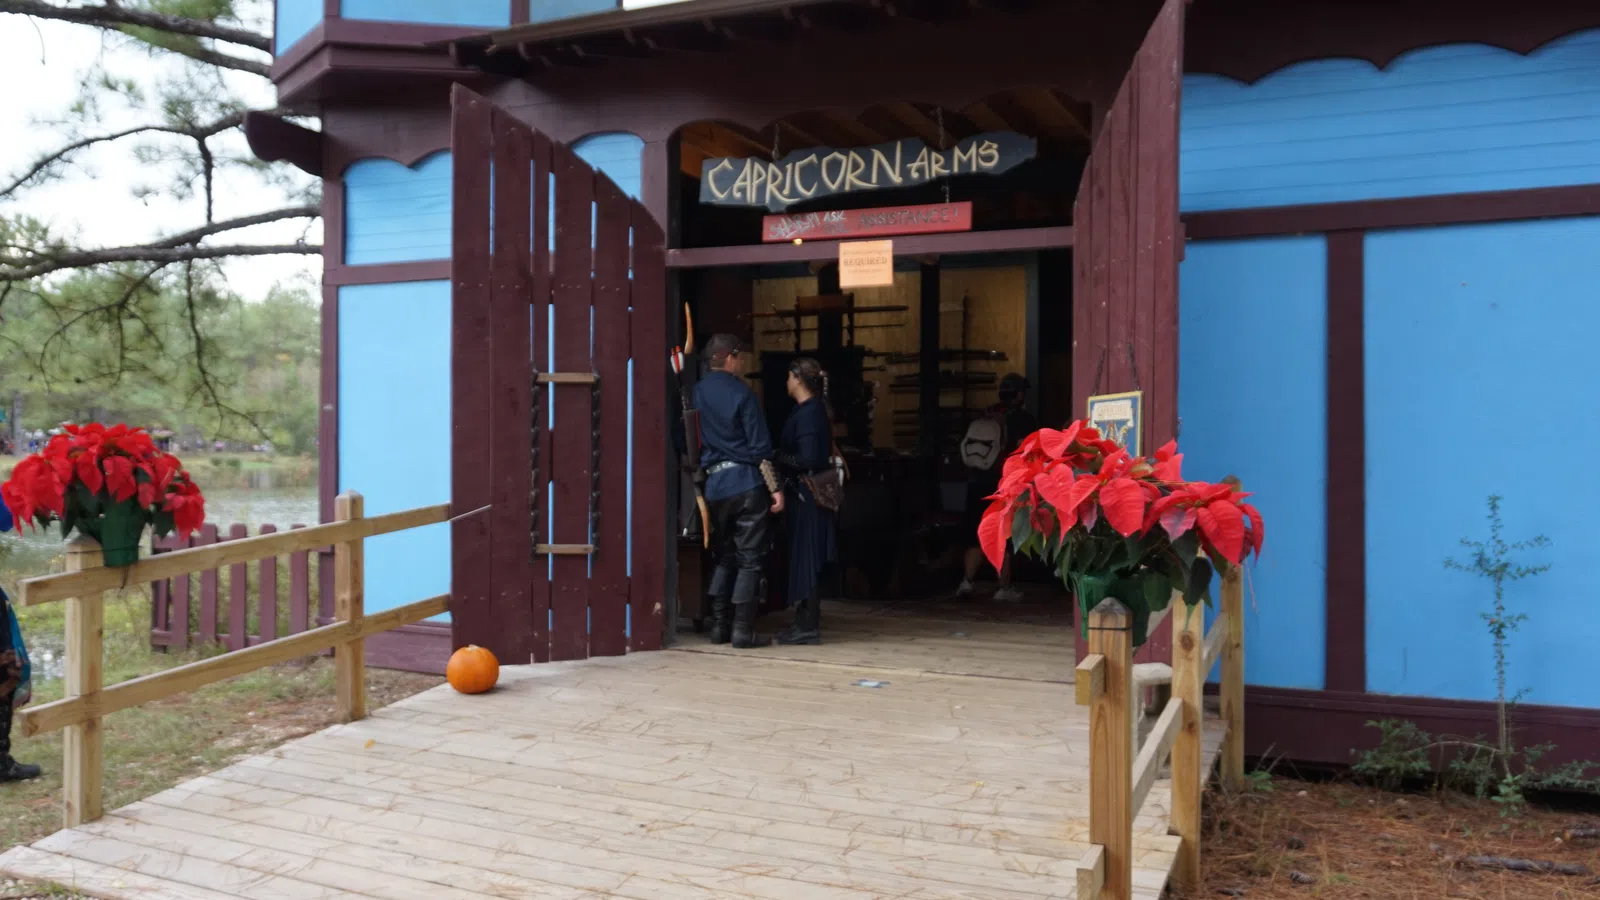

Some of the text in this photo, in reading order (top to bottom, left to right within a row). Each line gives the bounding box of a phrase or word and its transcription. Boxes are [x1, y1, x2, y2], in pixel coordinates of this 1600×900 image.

[707, 139, 1000, 205] CAPRICORN ARMS
[823, 210, 846, 222] ASK
